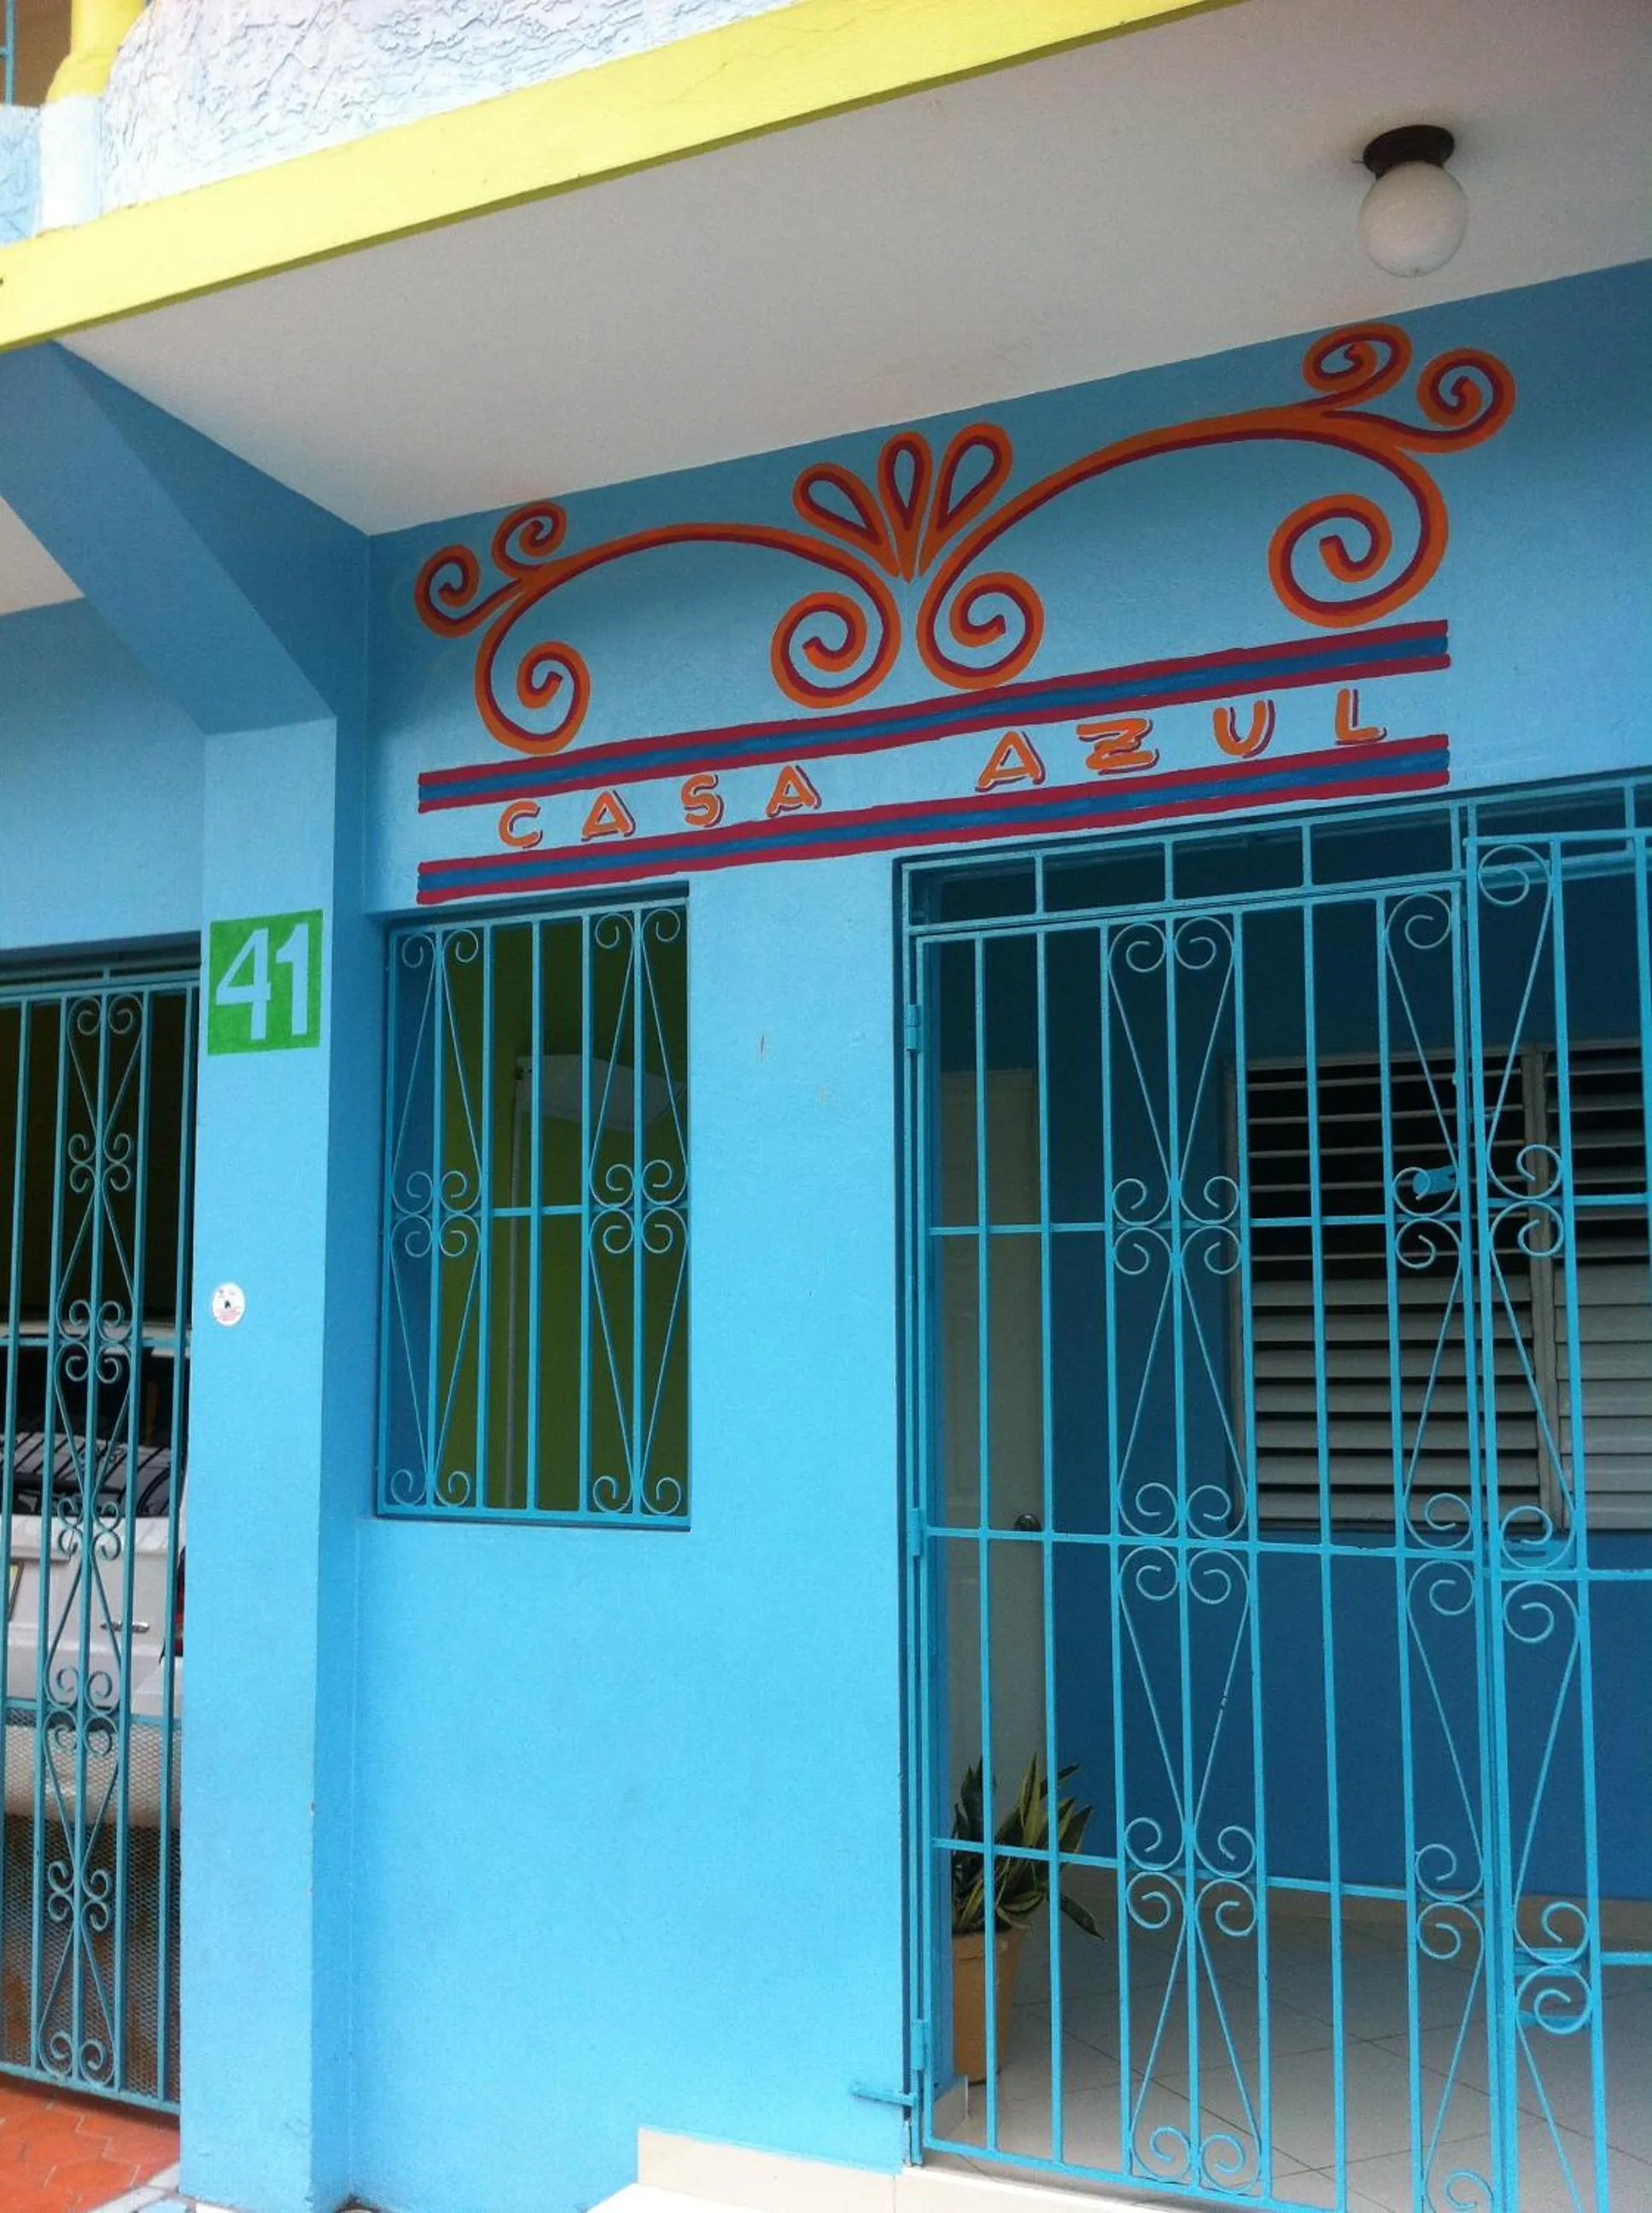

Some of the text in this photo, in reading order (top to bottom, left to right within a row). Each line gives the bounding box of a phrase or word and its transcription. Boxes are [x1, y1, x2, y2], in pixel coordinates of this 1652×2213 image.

[499, 688, 1387, 849] CASA AZUL
[215, 922, 310, 1041] 41
